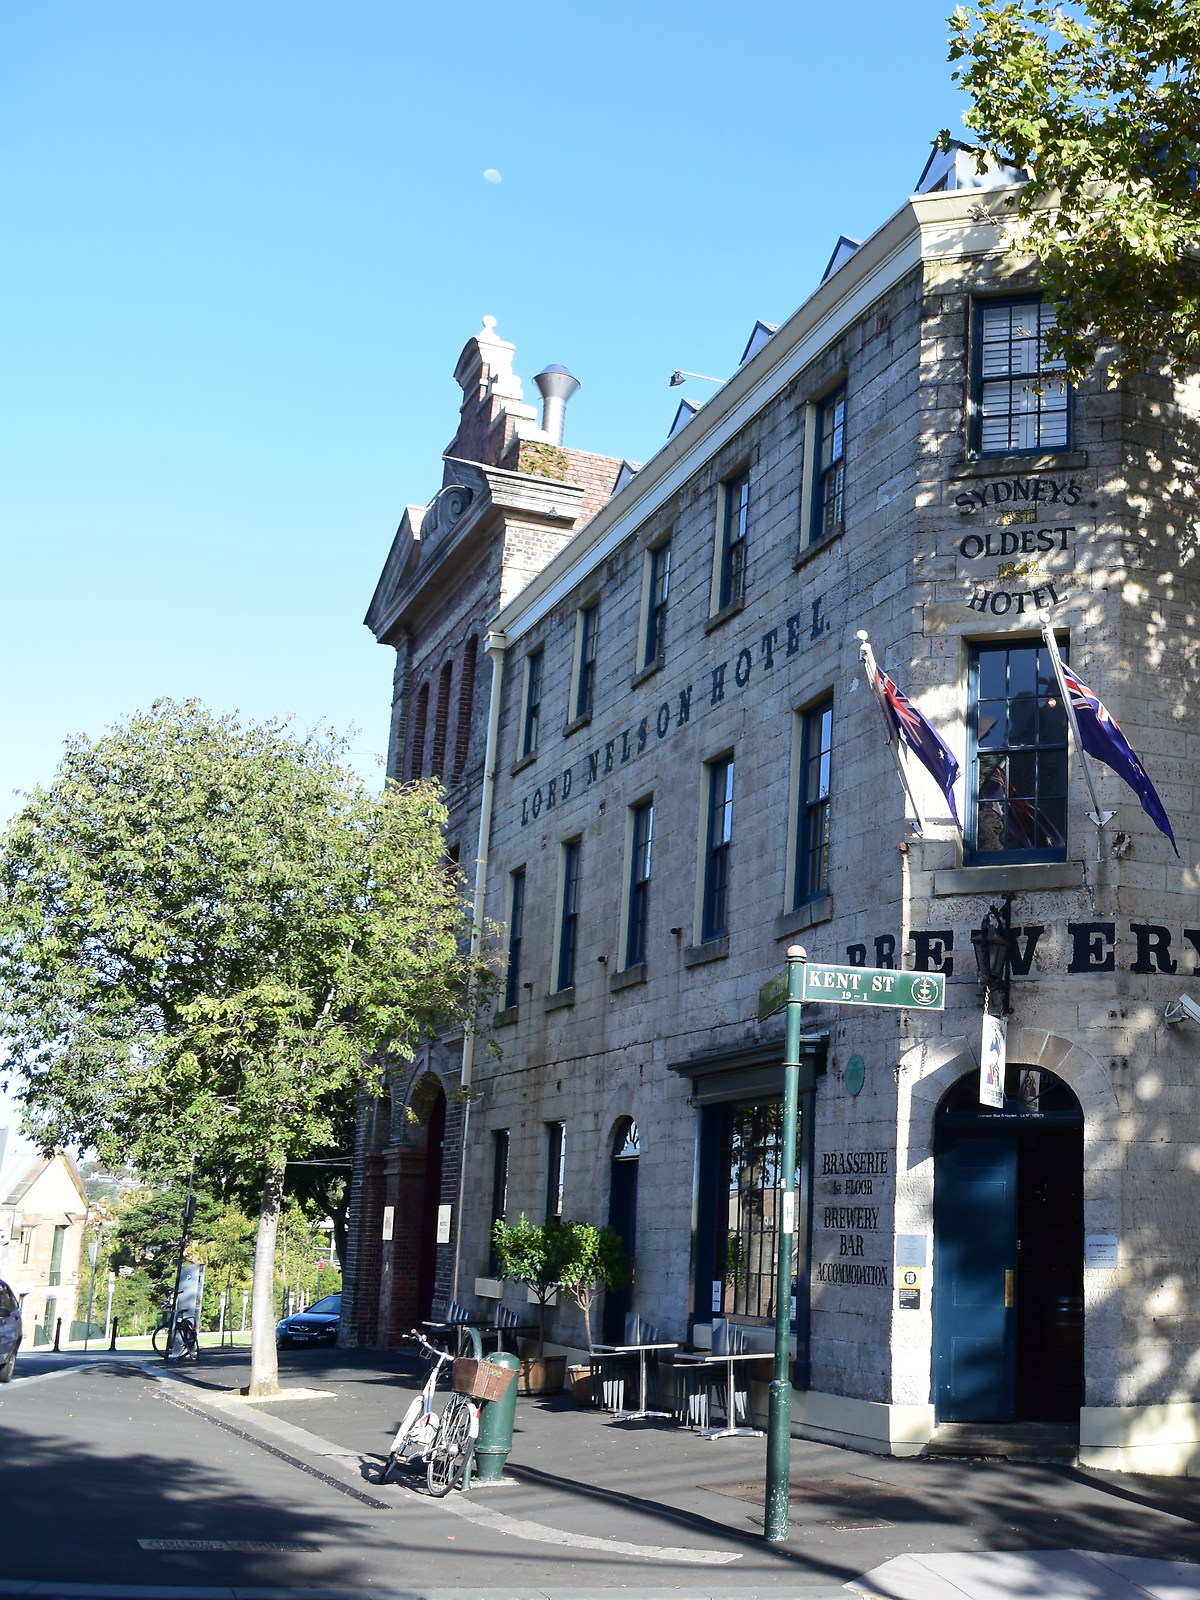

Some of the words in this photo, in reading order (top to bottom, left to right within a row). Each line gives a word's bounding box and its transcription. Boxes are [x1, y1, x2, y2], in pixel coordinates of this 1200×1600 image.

[955, 479, 1082, 516] SYDNEY'S
[1000, 508, 1036, 527] EST
[959, 526, 1076, 559] OLDEST
[997, 561, 1040, 579] 1842
[966, 583, 1069, 616] HOTEL
[520, 767, 573, 827] LORD
[586, 684, 692, 785] NELSON
[809, 971, 862, 990] KENT
[871, 975, 896, 993] ST
[841, 991, 852, 1000] 19
[822, 1152, 888, 1175] BRASSERIE
[845, 1179, 873, 1195] FLOOR
[824, 1207, 879, 1229] BREWERY
[840, 1234, 865, 1257] BAR
[816, 1262, 888, 1286] ACCOMMODATION
